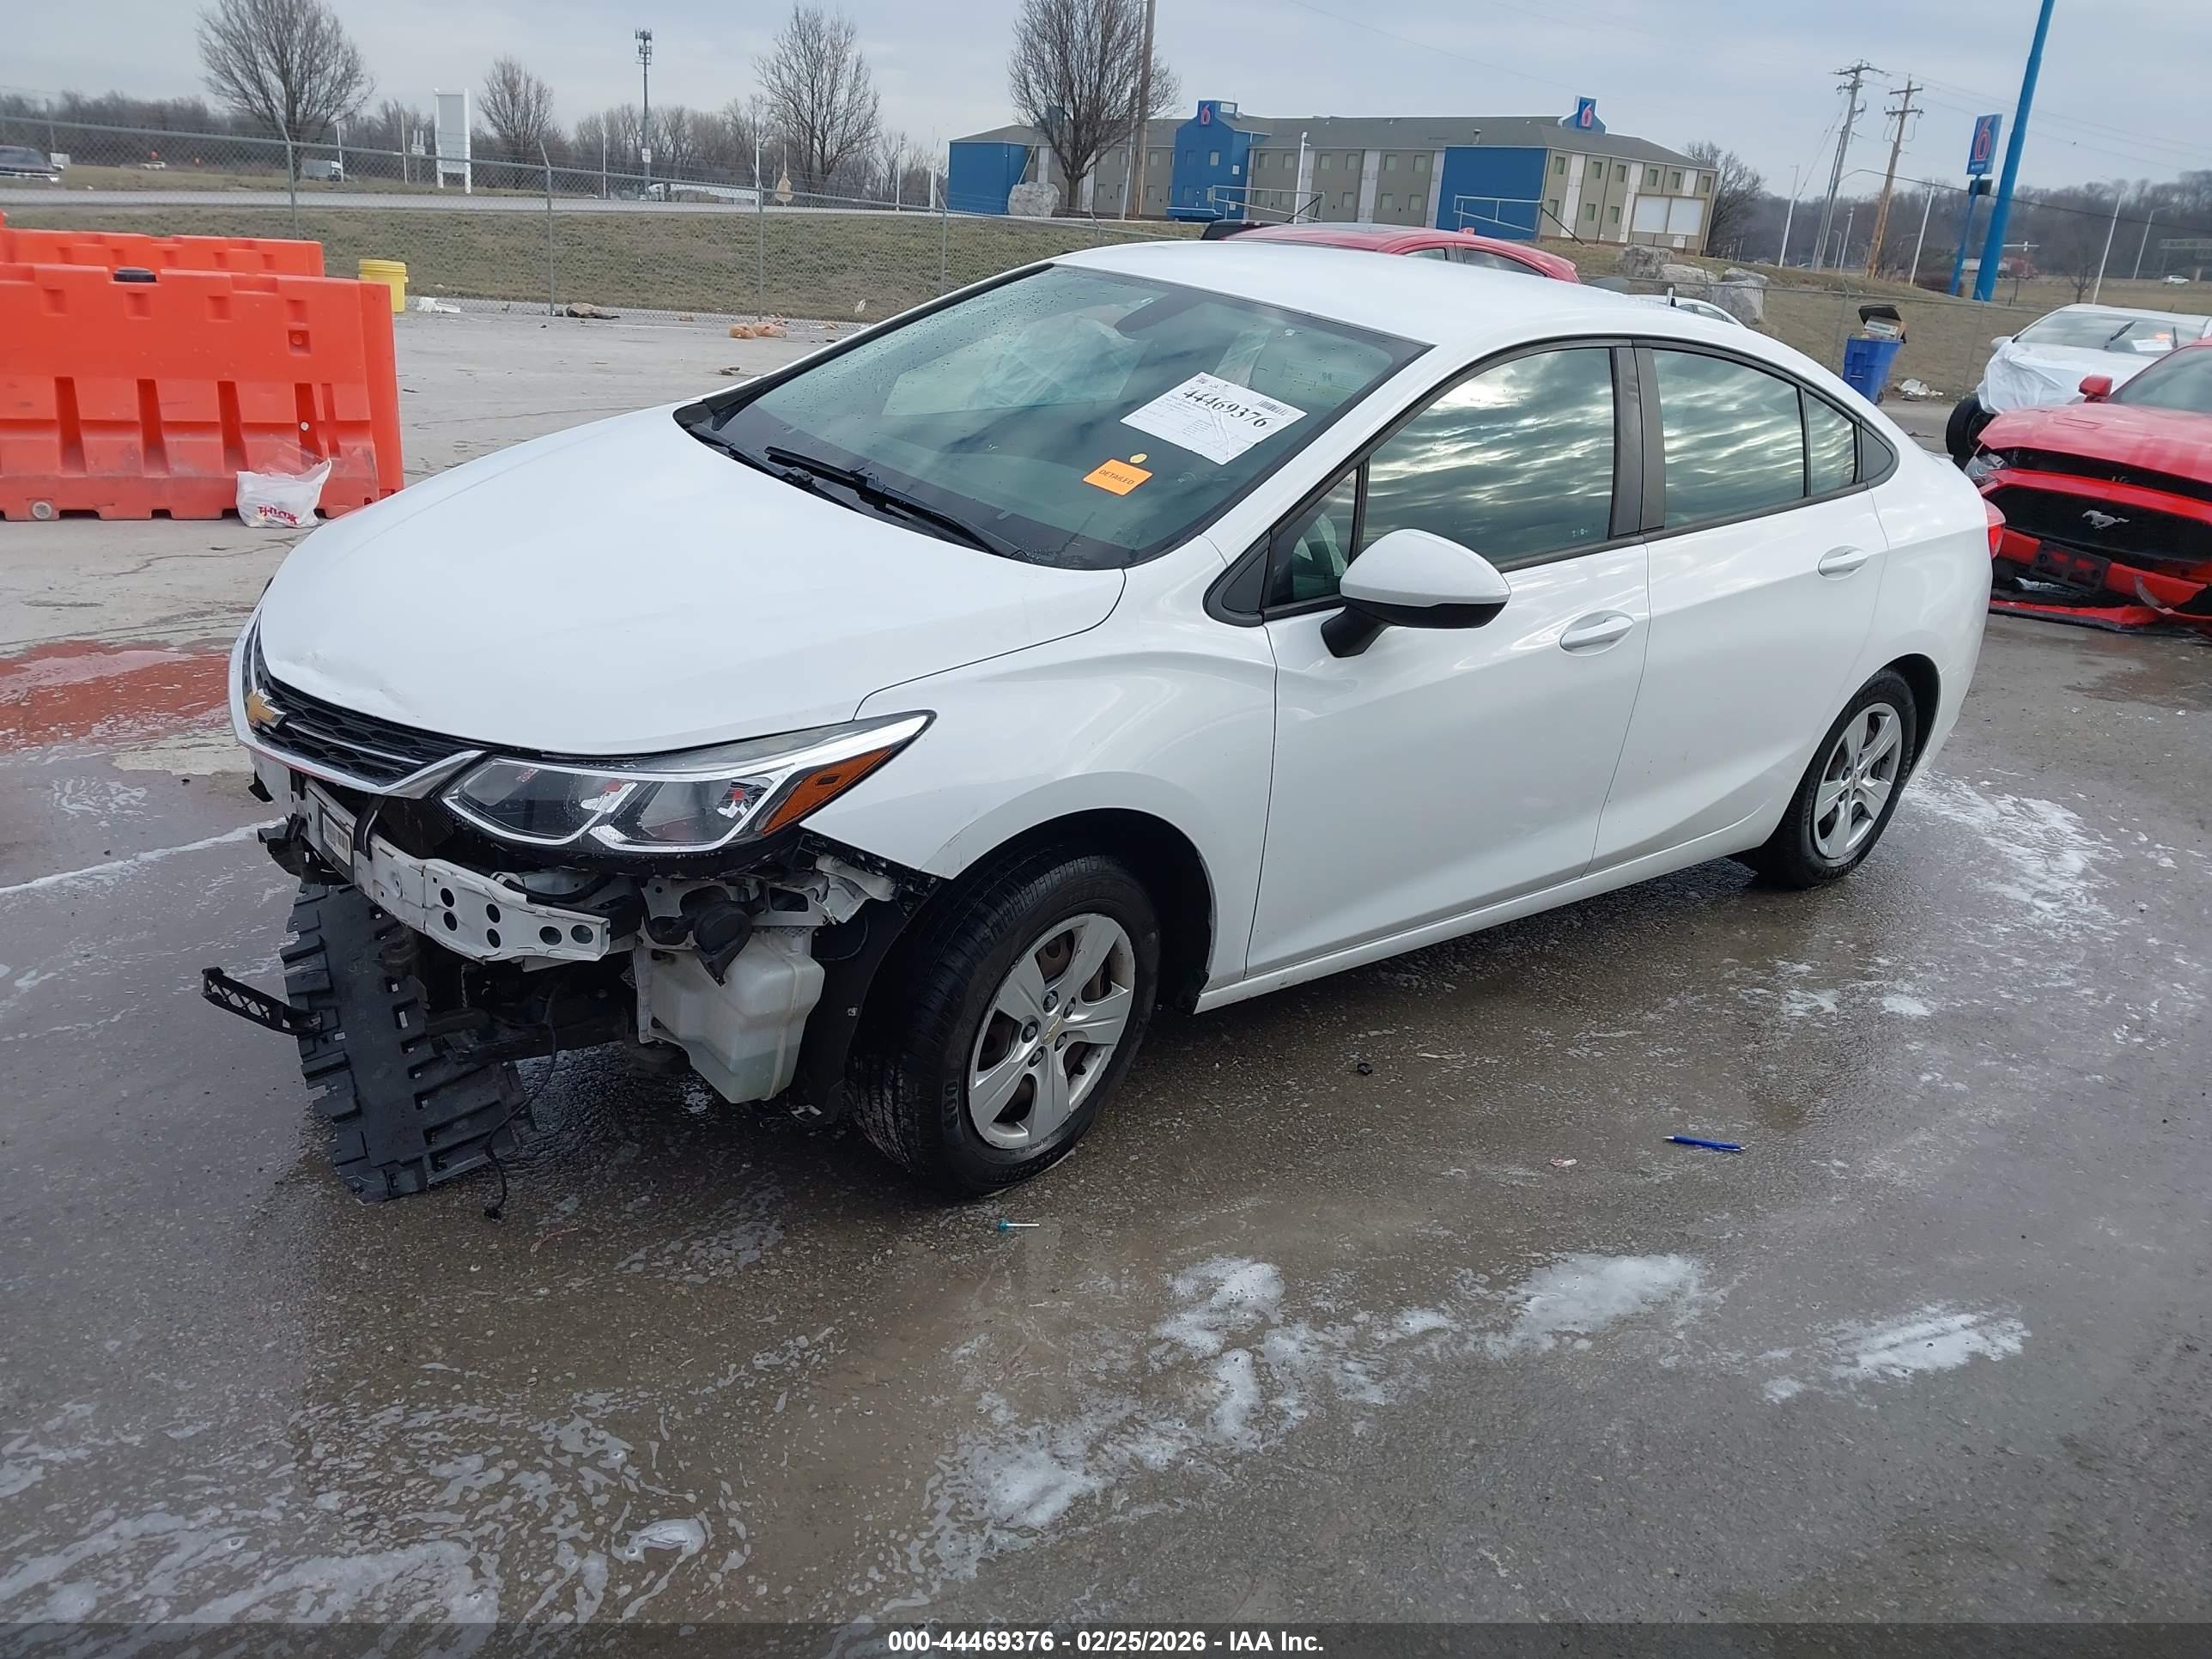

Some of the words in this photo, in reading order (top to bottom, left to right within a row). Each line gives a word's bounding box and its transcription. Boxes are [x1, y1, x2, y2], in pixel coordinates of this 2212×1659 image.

[1200, 103, 1211, 125] 6
[1580, 103, 1593, 127] 6
[1975, 116, 1993, 161] 6
[1182, 388, 1275, 428] 44469376
[1099, 469, 1135, 486] DETAILED
